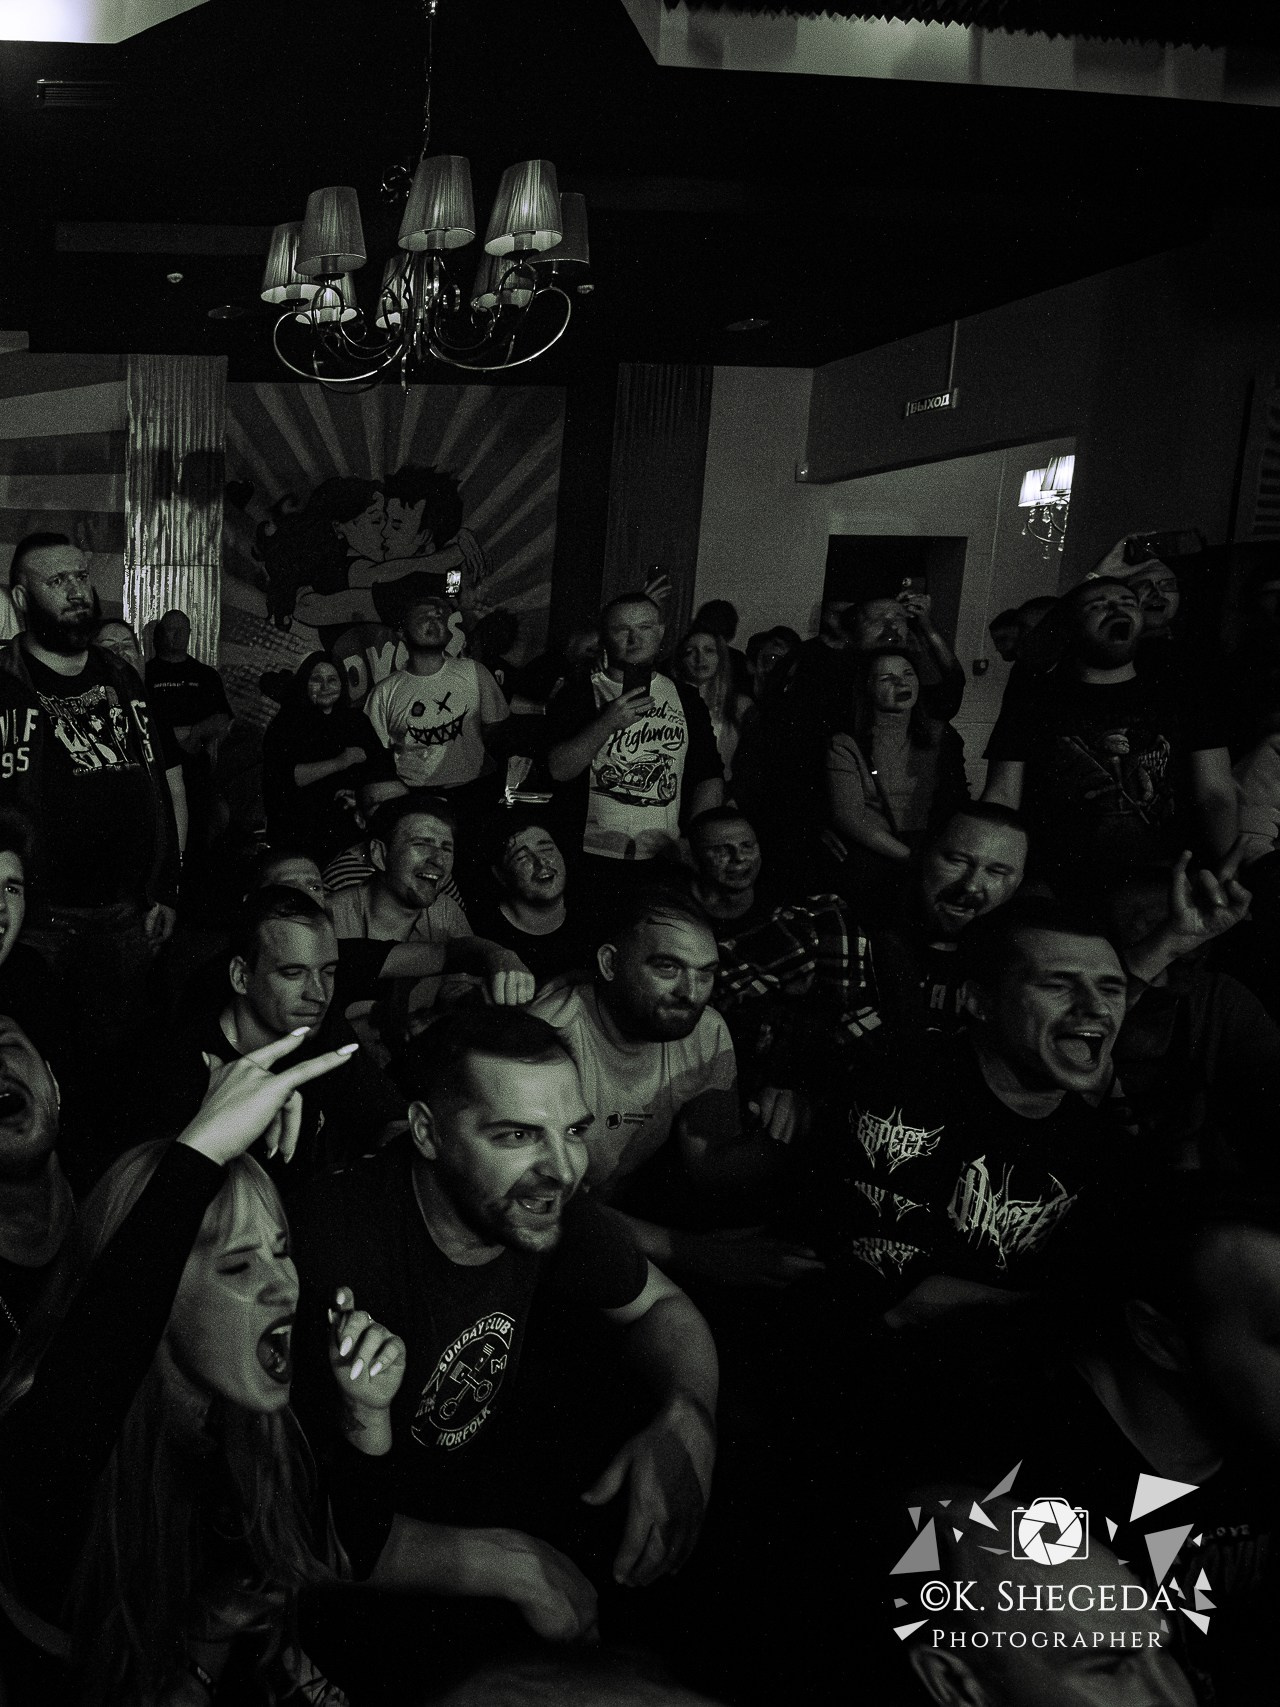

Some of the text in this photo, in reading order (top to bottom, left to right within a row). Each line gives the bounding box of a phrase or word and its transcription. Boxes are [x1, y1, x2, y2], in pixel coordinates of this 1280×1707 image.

[910, 393, 950, 414] ВЫХОД
[606, 721, 685, 758] Highway
[1, 746, 31, 779] 95
[439, 1317, 512, 1373] SUNDAY CLUB
[436, 1404, 492, 1447] NORFOLK
